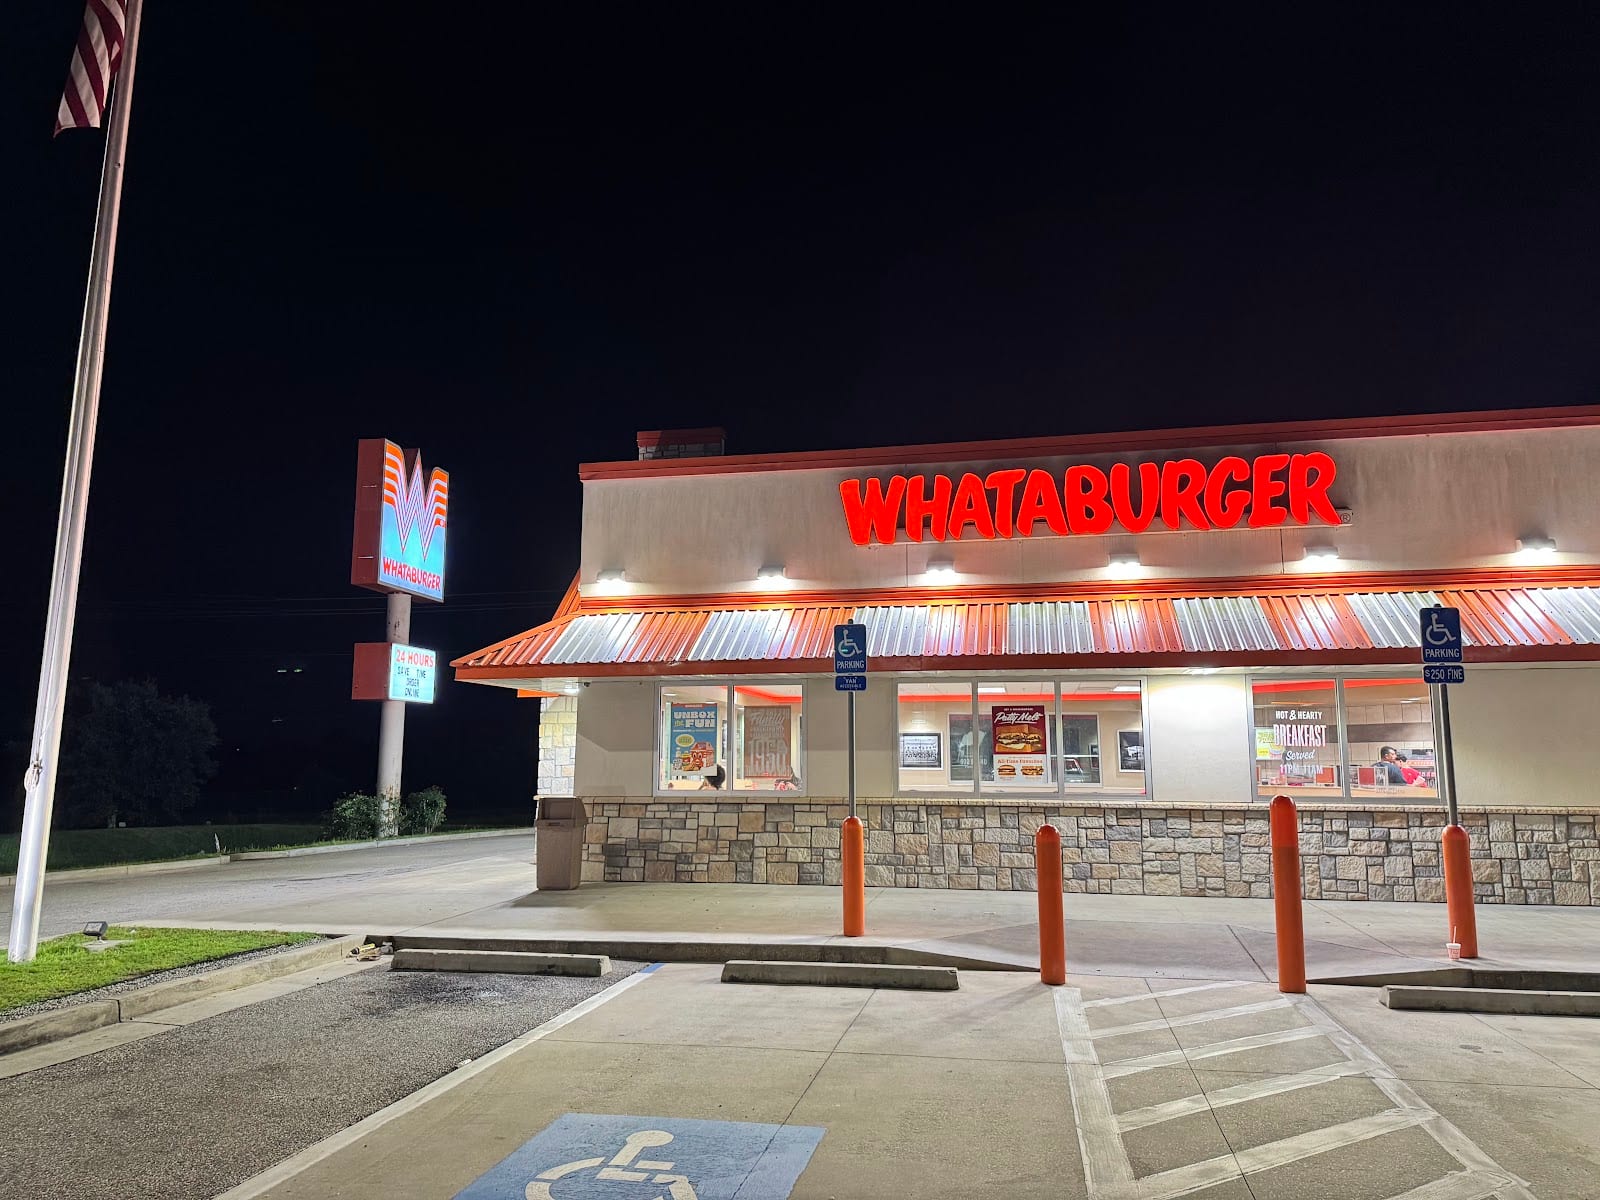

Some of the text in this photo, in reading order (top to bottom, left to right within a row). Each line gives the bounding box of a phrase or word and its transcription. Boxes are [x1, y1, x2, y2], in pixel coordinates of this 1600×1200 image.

[839, 452, 1341, 545] WHATABURGER
[382, 557, 441, 592] WHATABURGER
[396, 649, 434, 668] 24 HOURS
[1425, 648, 1459, 657] PARKING
[837, 660, 864, 669] PARKING
[1425, 668, 1463, 680] $250 FINE
[673, 711, 715, 719] UNBOX
[994, 711, 1043, 724] Patty Melt
[1275, 709, 1322, 721] HOT & HEARTY
[685, 719, 715, 728] FUN
[1273, 723, 1327, 747] BREAKFAST
[1285, 748, 1315, 761] Served
